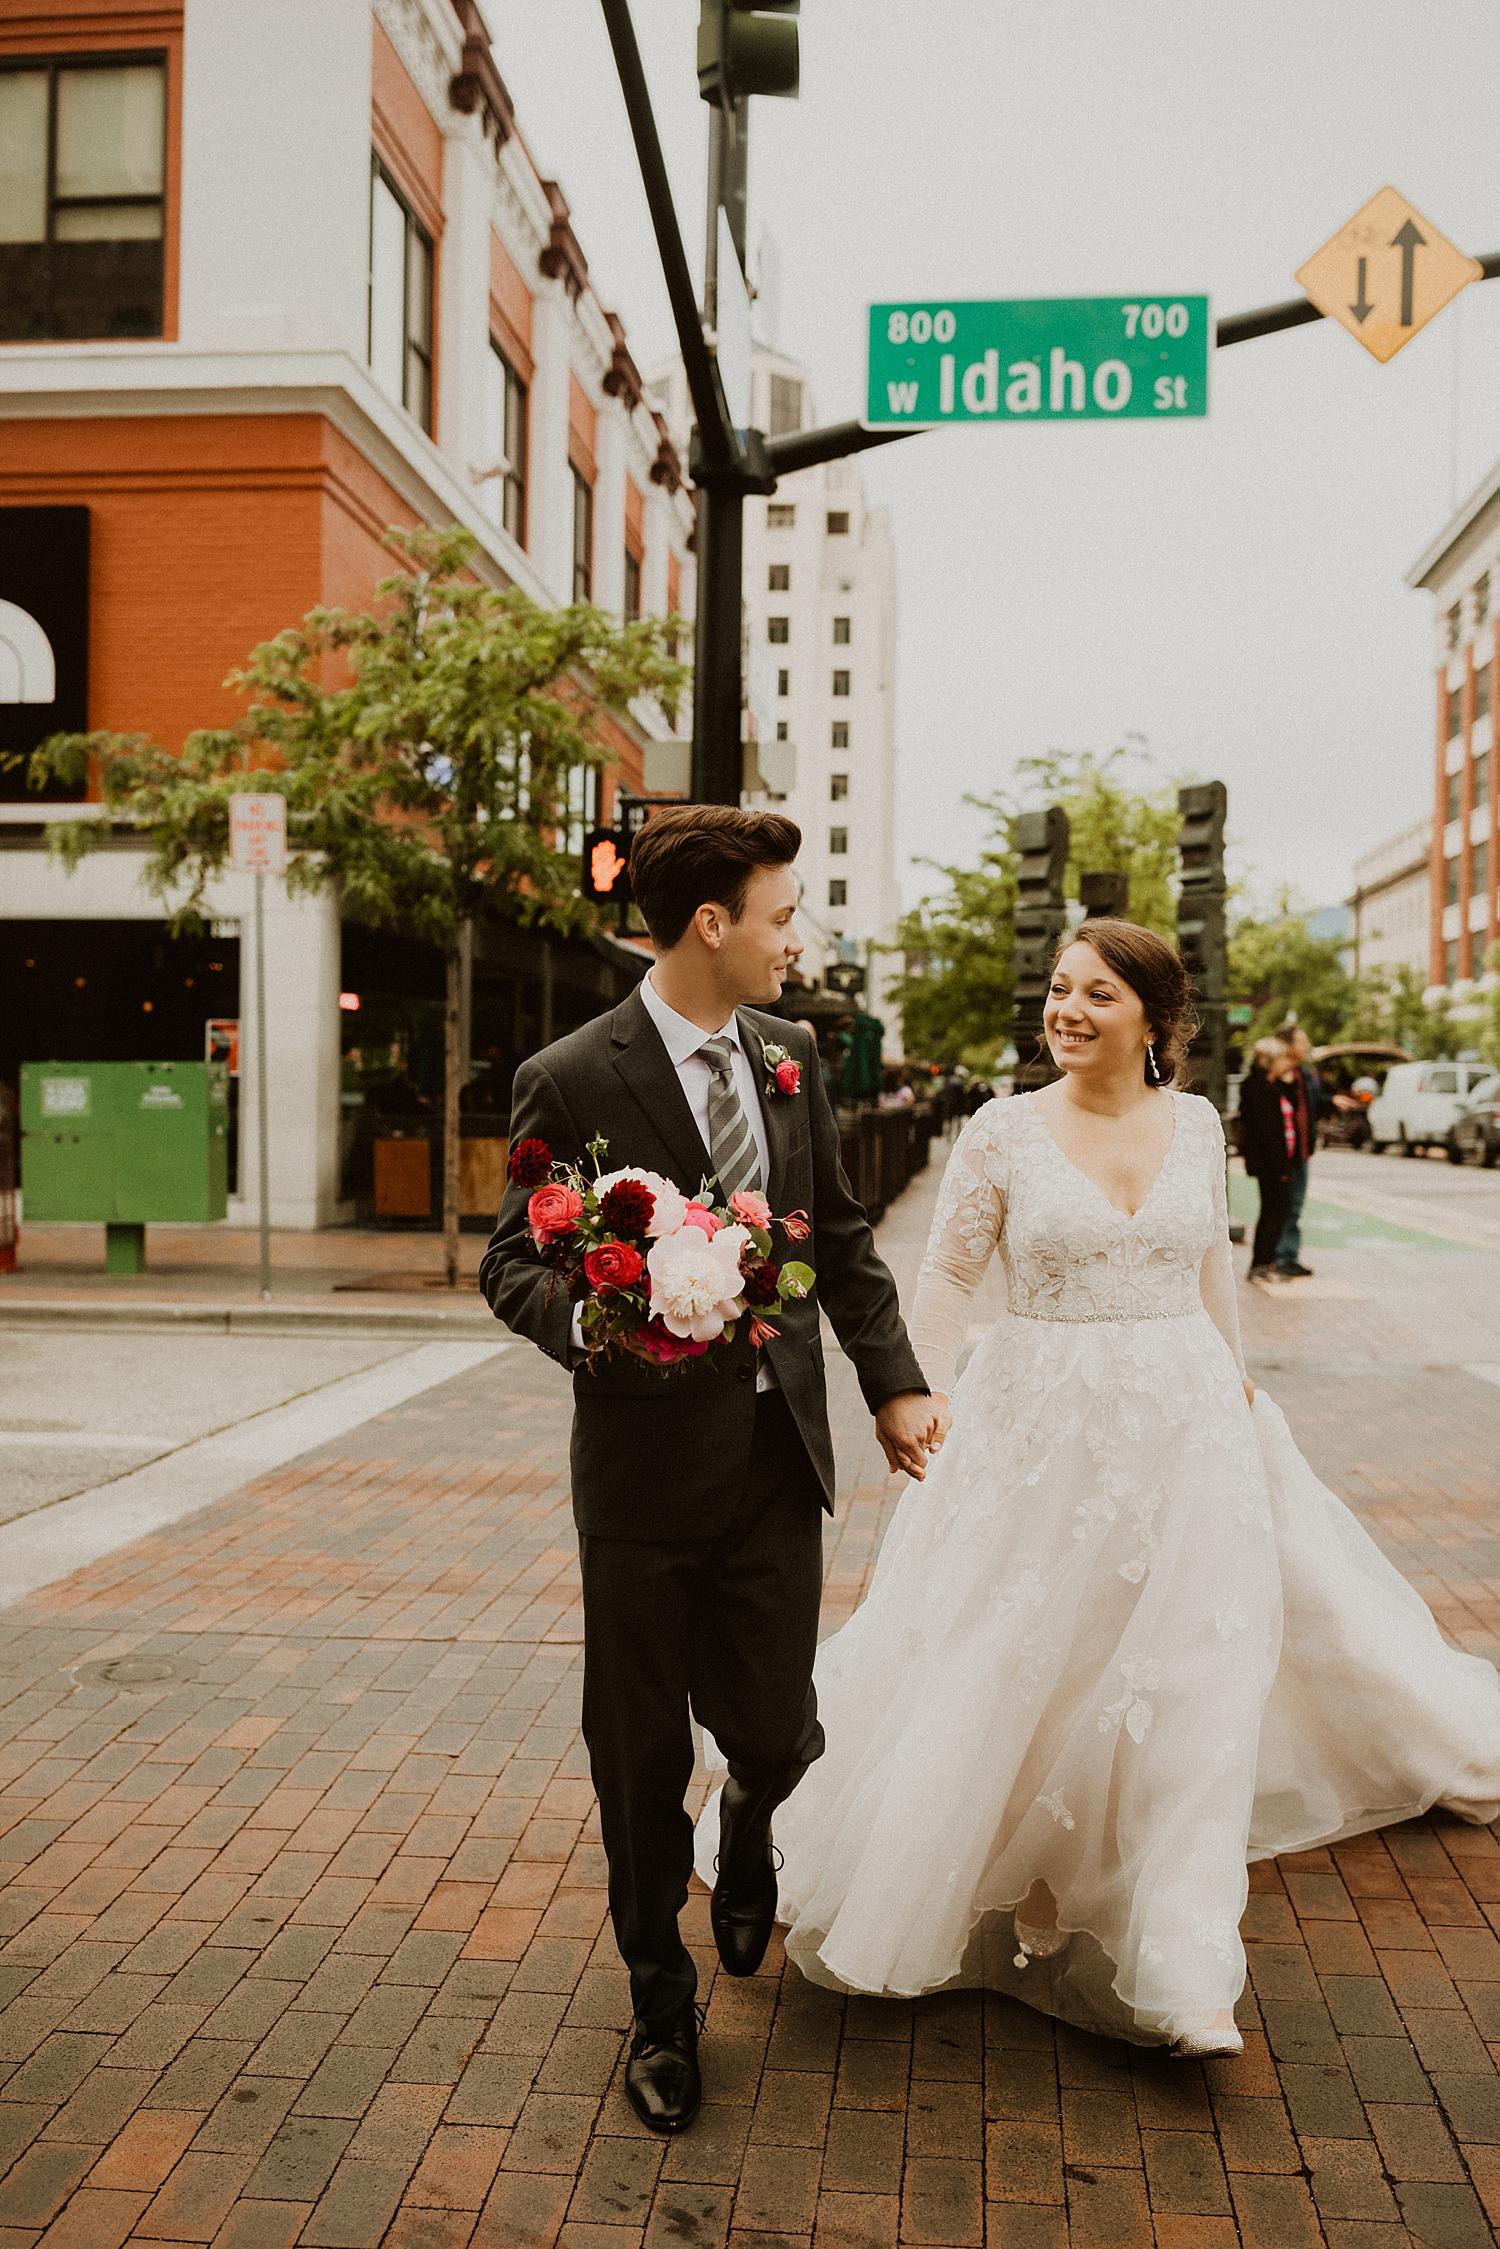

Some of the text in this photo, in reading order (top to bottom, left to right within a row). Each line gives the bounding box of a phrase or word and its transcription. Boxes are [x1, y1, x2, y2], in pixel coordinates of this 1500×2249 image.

[888, 310, 956, 344] 800
[1121, 304, 1189, 339] 700
[887, 348, 1188, 414] W Idaho St
